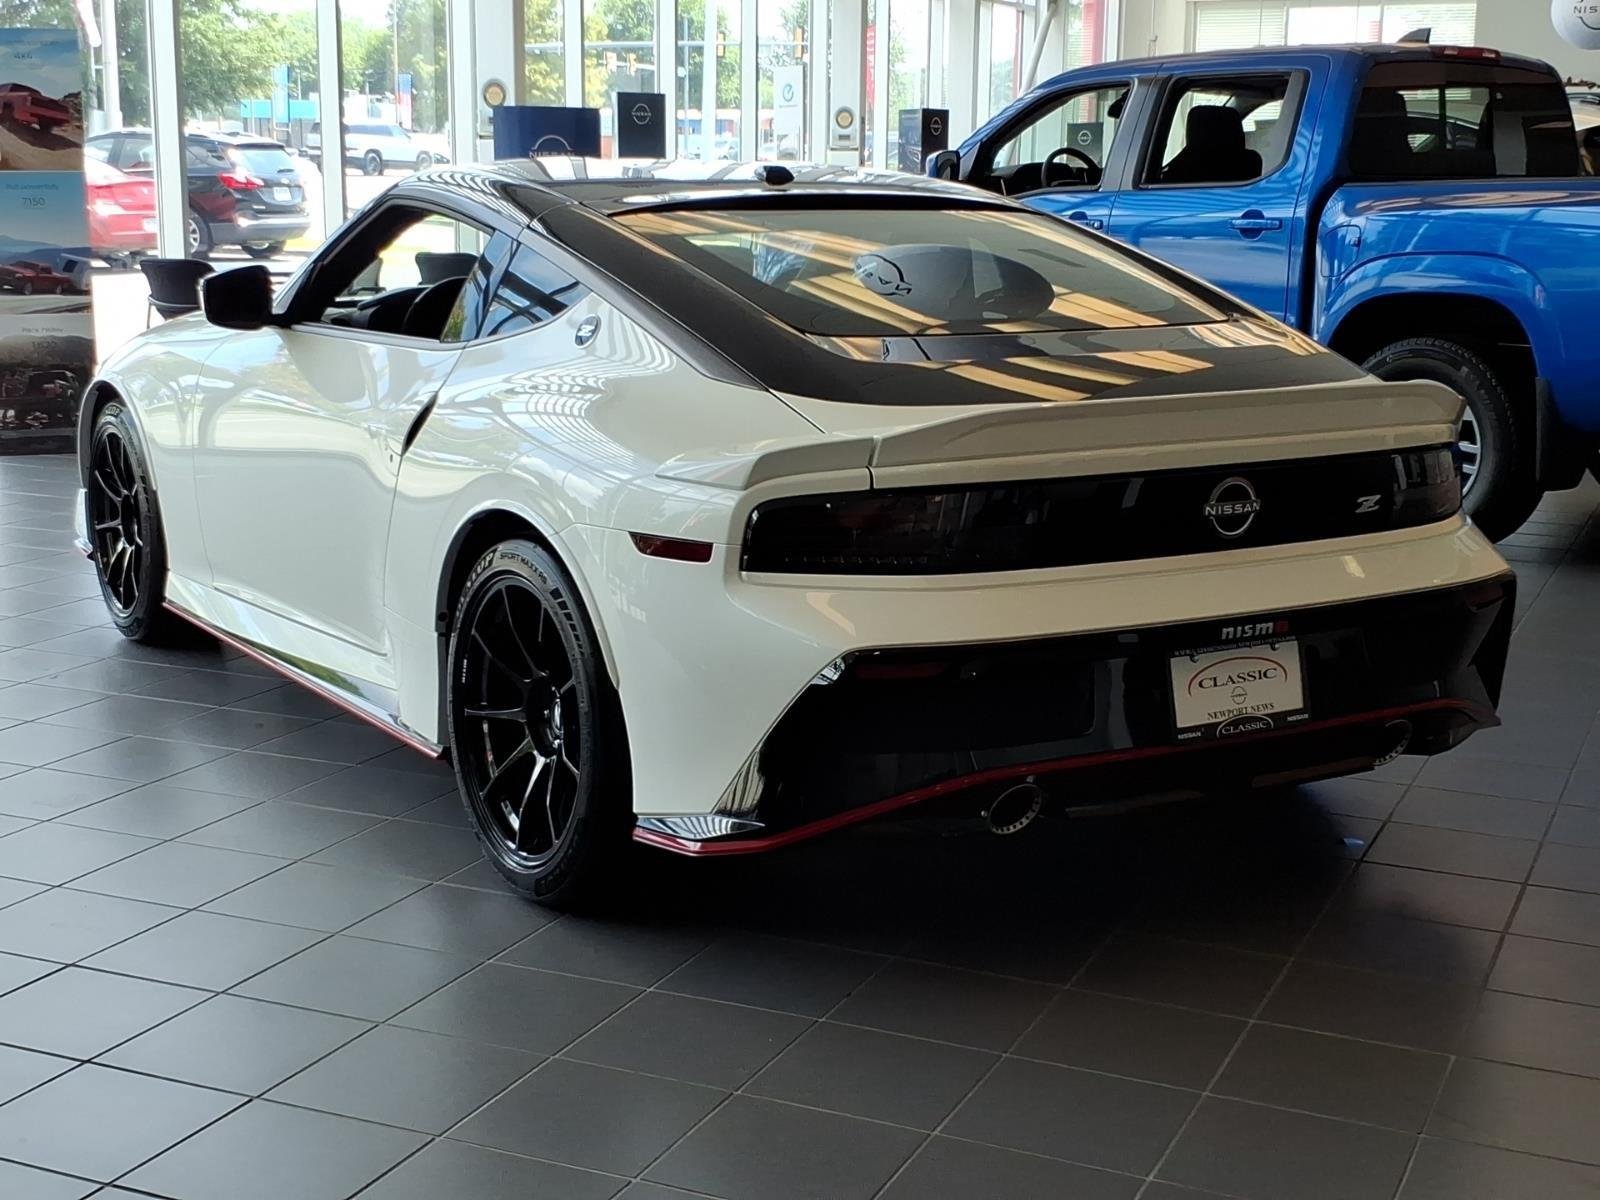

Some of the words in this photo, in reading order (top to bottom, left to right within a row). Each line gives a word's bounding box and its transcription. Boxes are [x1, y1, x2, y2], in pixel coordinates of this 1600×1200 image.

[1205, 502, 1261, 516] NISSAN
[1355, 494, 1382, 513] Z
[1198, 668, 1277, 688] CLASSIC
[1207, 705, 1249, 720] NEWPORT
[1250, 702, 1275, 715] NEWS
[1222, 721, 1268, 734] CLASSIC
